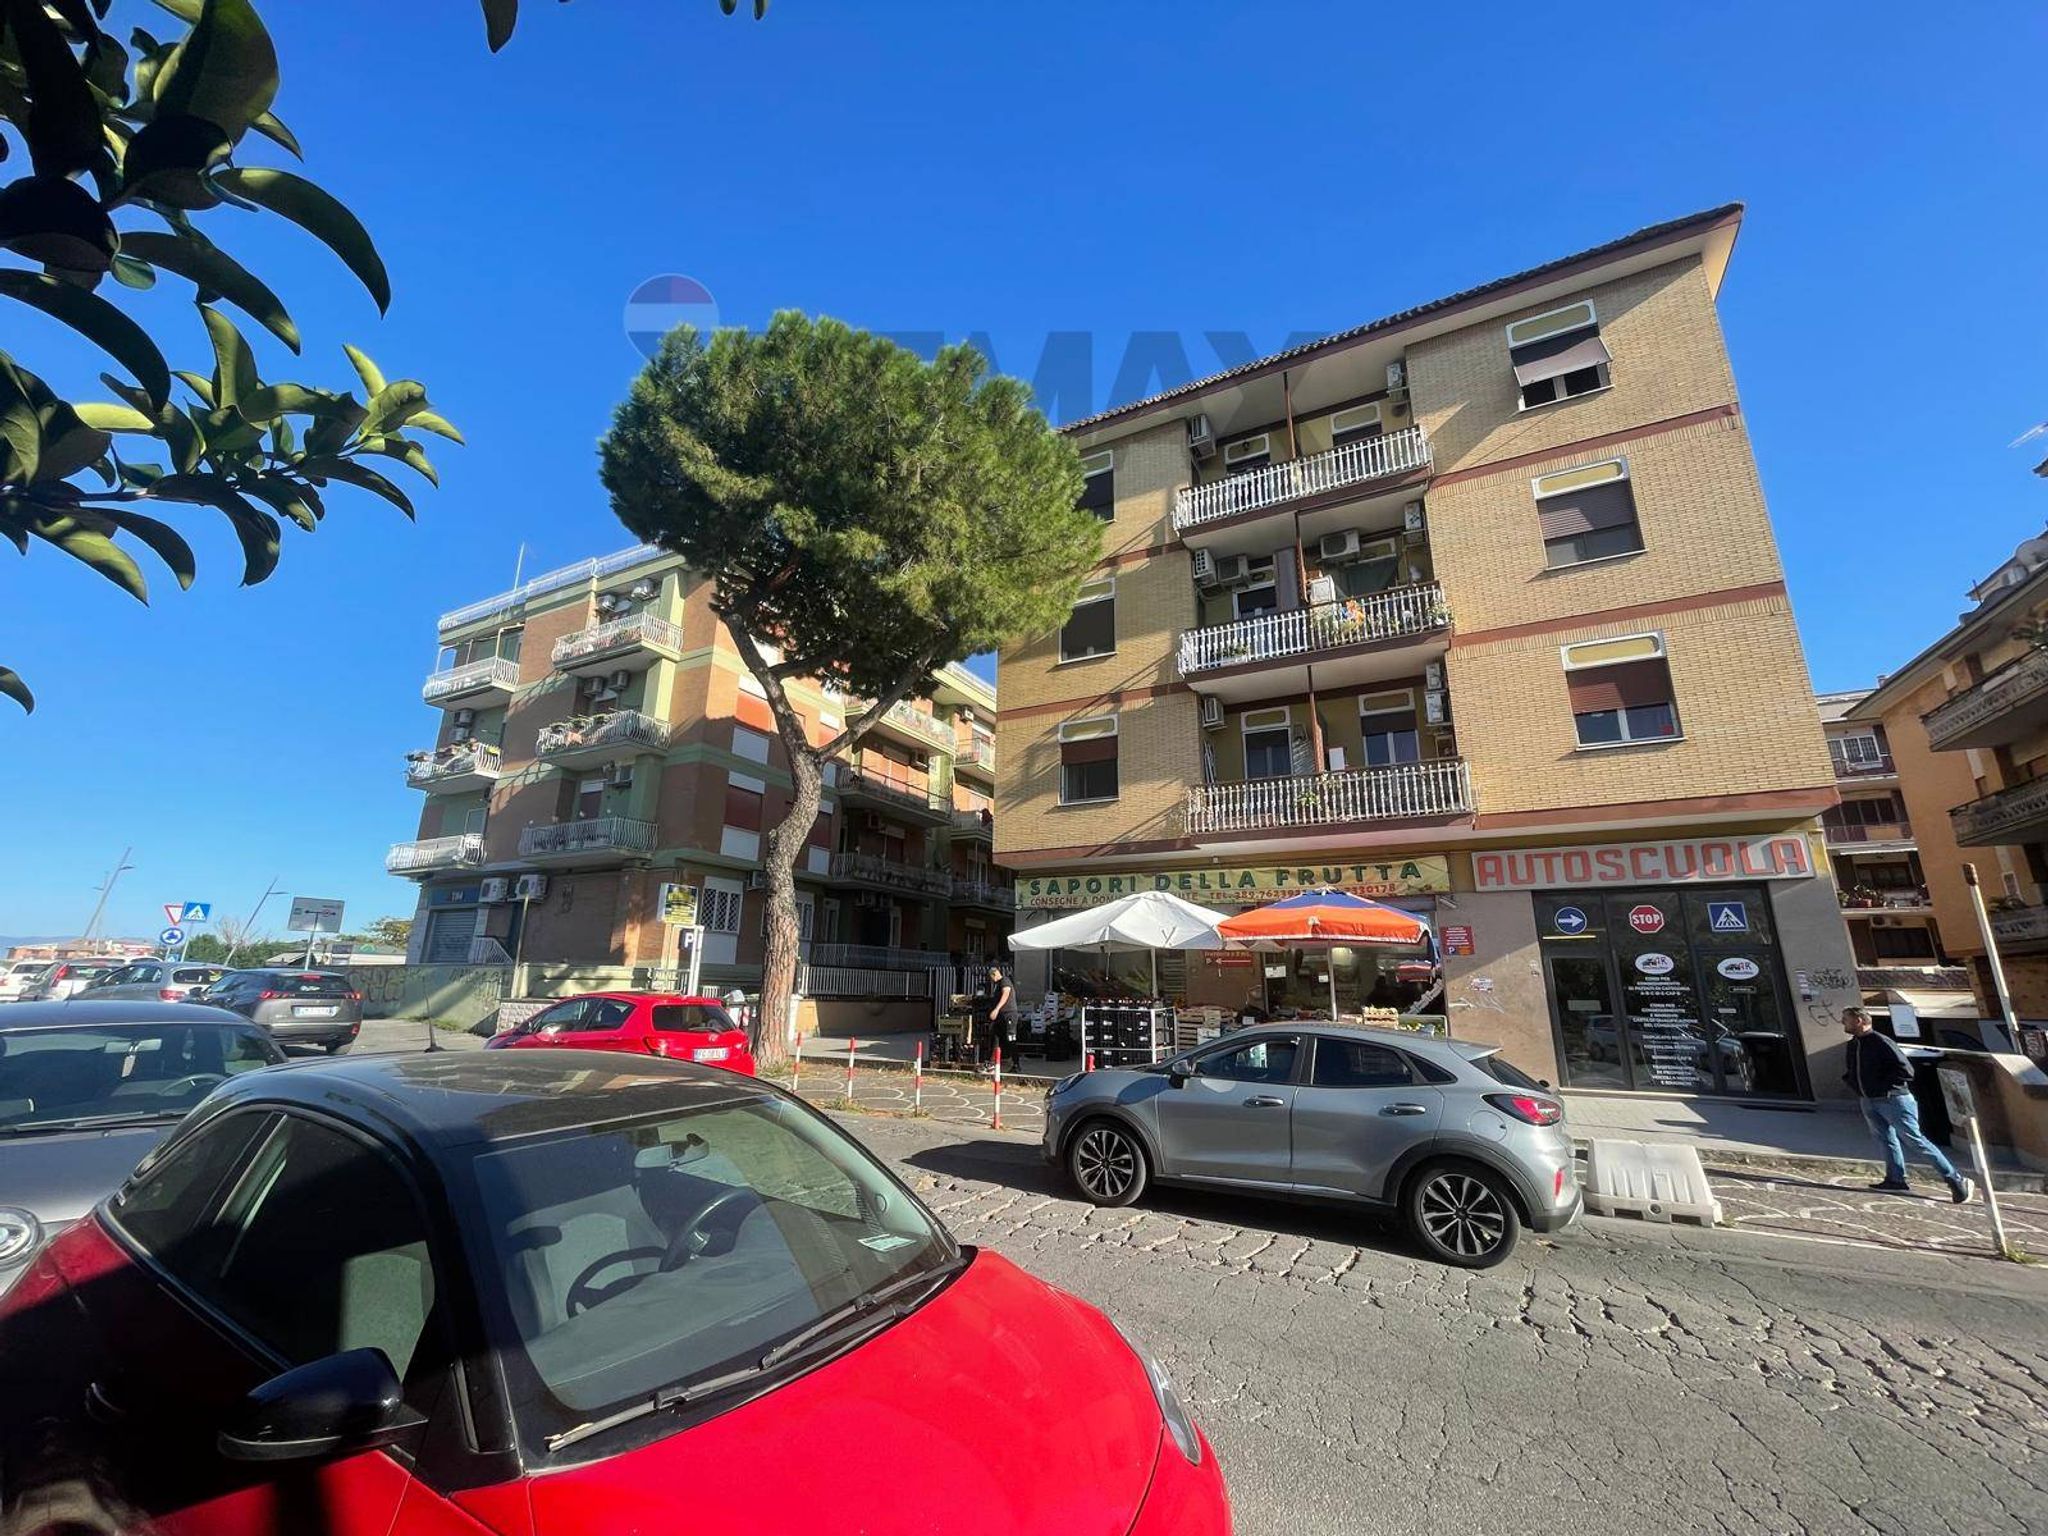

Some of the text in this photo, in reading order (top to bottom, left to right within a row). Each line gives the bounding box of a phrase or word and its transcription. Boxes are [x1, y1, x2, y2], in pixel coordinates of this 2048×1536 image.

[1478, 838, 1807, 887] AUTOSCUOLA
[1030, 862, 1421, 895] SAPORI DELLA FRUTTA
[1030, 894, 1080, 906] CONSEGNE
[1082, 896, 1089, 904] A
[1632, 913, 1660, 925] STOP
